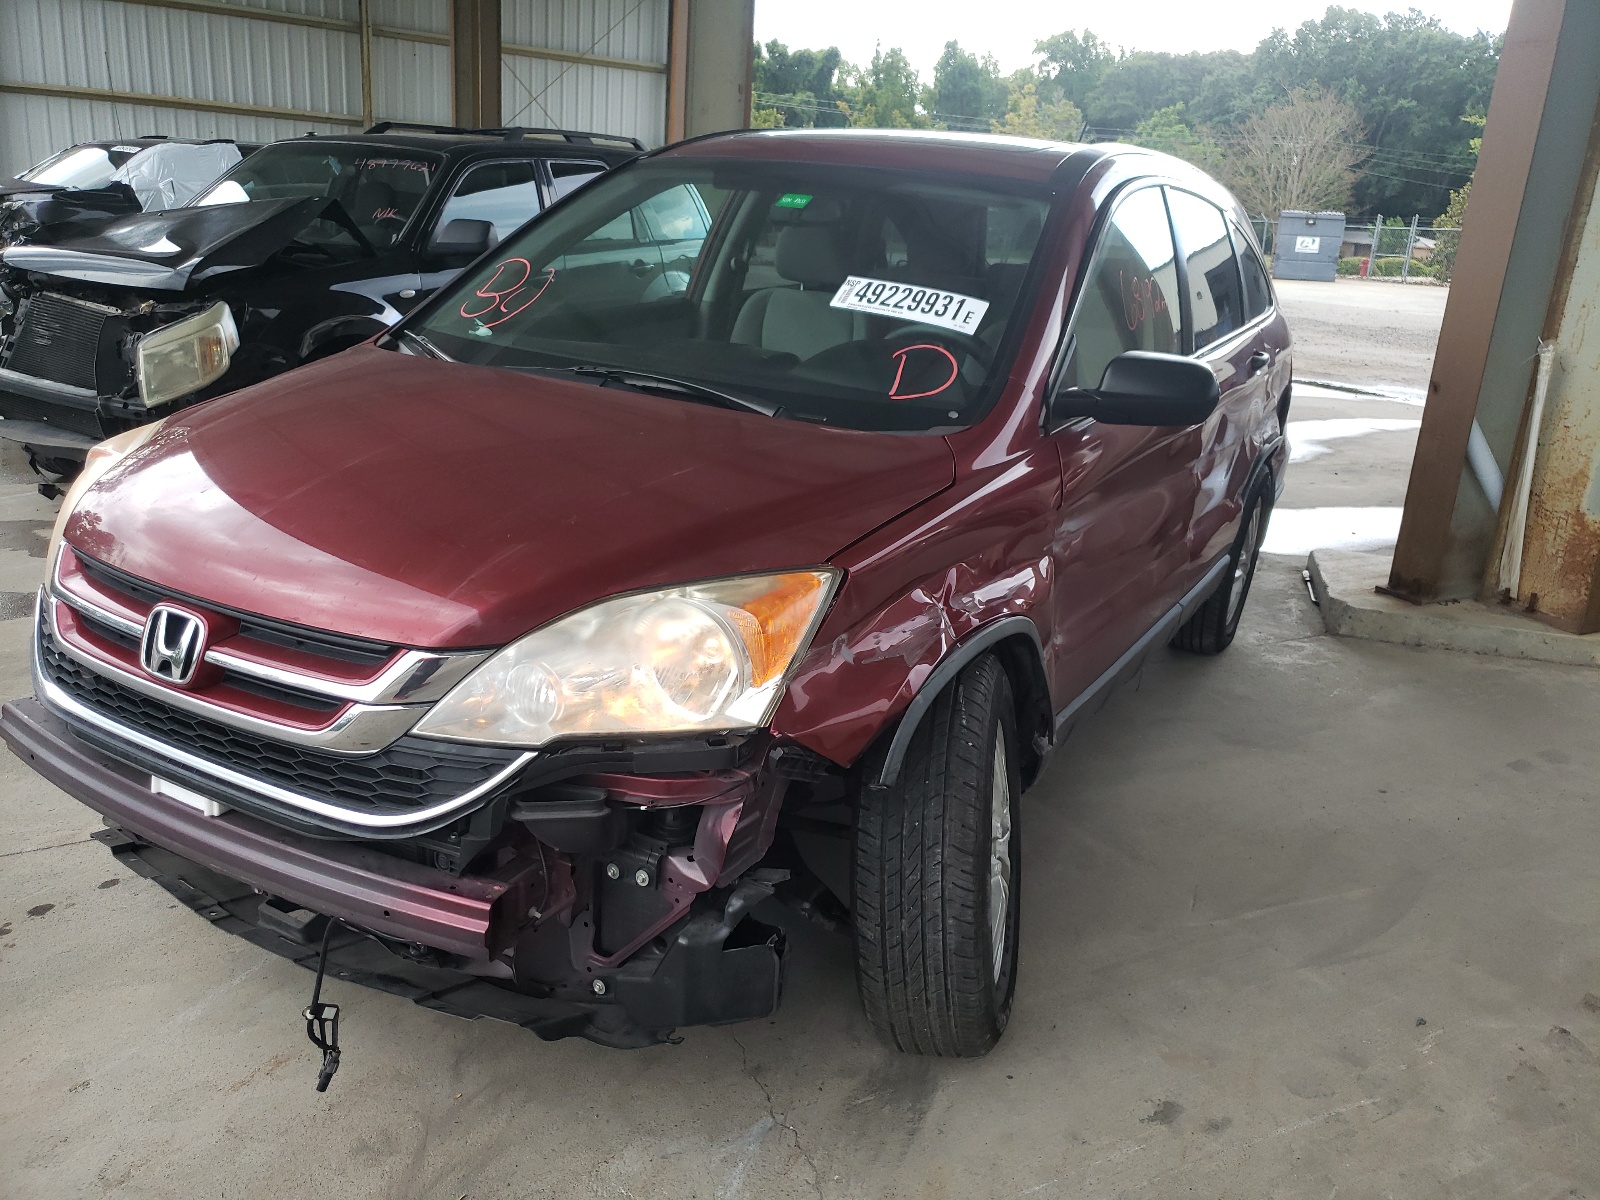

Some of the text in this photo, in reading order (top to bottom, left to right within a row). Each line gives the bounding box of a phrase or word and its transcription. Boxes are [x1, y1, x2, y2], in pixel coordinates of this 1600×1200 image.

[845, 279, 861, 288] NSP
[854, 281, 967, 321] 49229931
[963, 310, 975, 325] E
[888, 344, 958, 400] D
